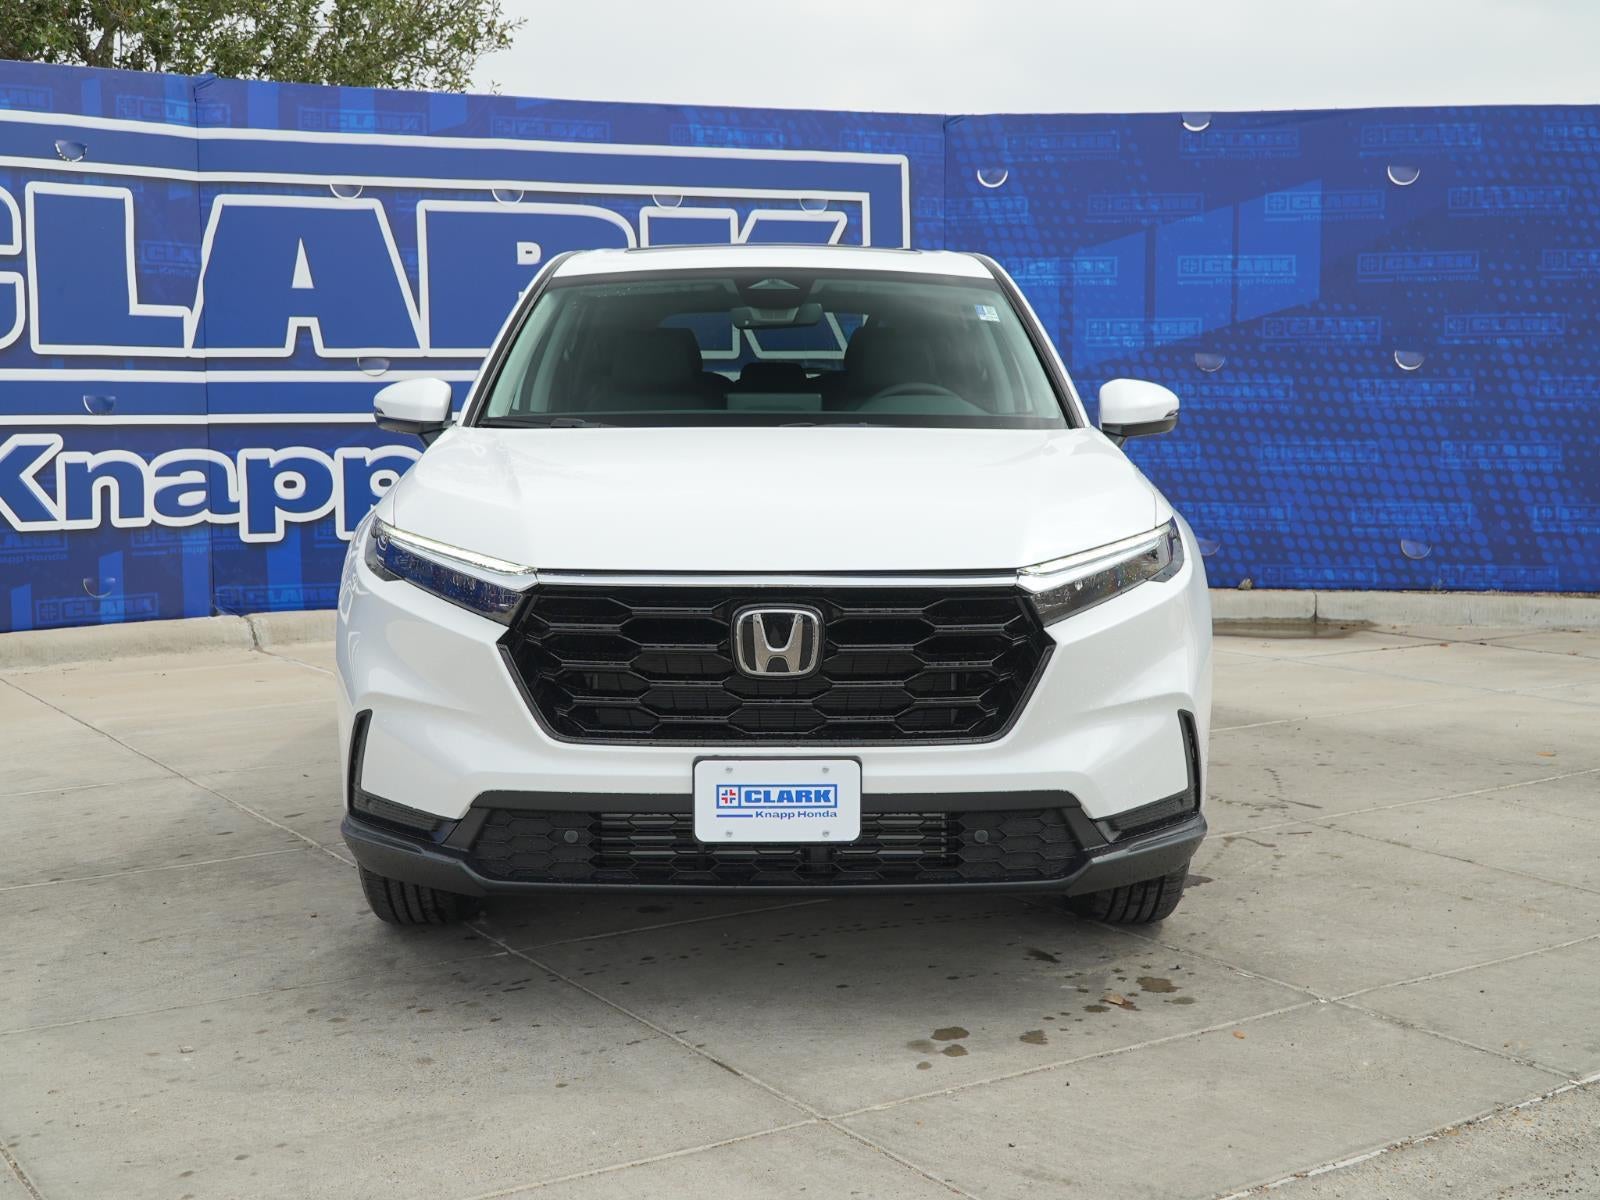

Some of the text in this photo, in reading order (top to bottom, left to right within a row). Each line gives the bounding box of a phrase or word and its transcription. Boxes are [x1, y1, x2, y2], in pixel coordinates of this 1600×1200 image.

[744, 789, 832, 804] CLARK
[755, 810, 838, 820] Knapp Honda
